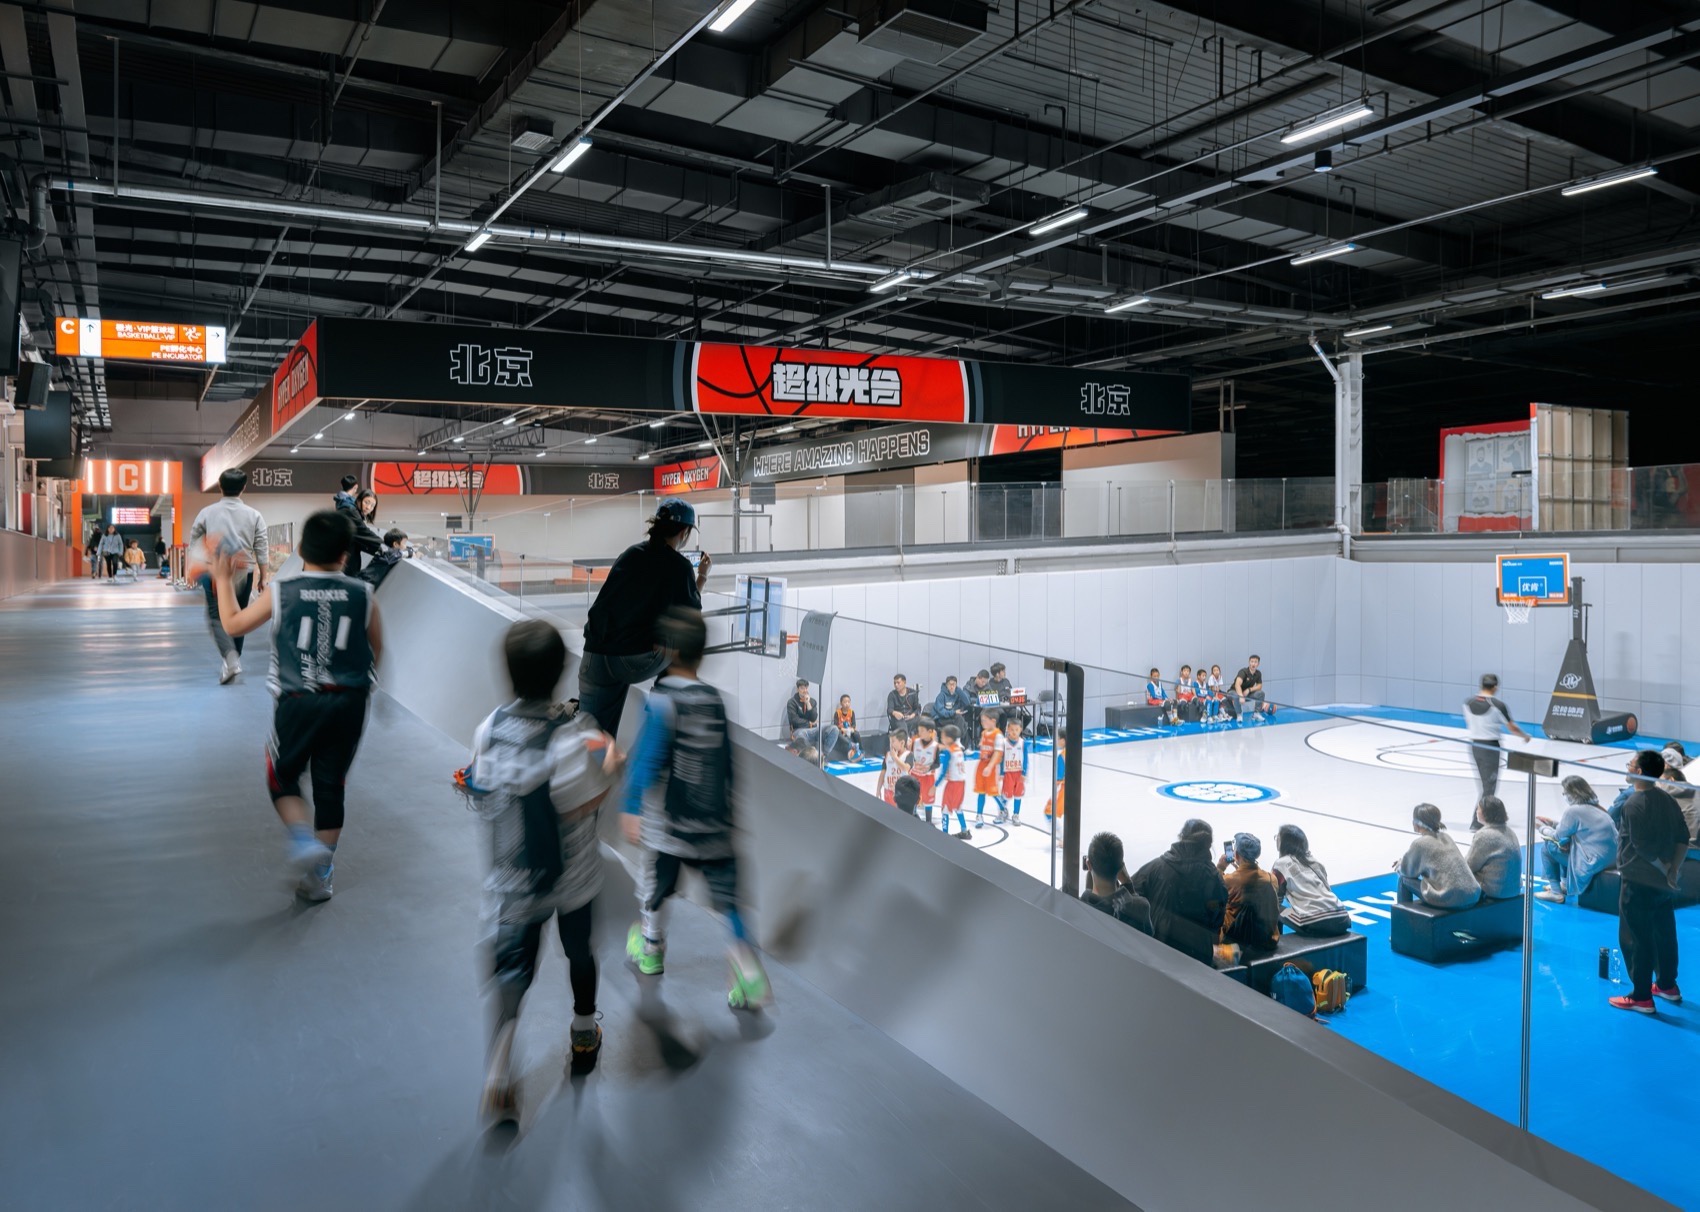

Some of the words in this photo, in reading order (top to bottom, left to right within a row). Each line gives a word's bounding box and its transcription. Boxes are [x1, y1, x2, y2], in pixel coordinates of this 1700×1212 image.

[61, 320, 75, 334] C
[450, 344, 533, 387] 北京
[1080, 382, 1131, 416] 北京
[753, 450, 791, 477] WHERE
[794, 442, 854, 472] AMAZING
[857, 429, 930, 463] HAPPENS
[118, 463, 138, 491] C
[252, 468, 293, 486] 北京
[588, 473, 620, 489] 北京
[661, 471, 681, 487] HYPER
[683, 467, 709, 484] OXYGEN
[300, 589, 349, 601] ROOKIE
